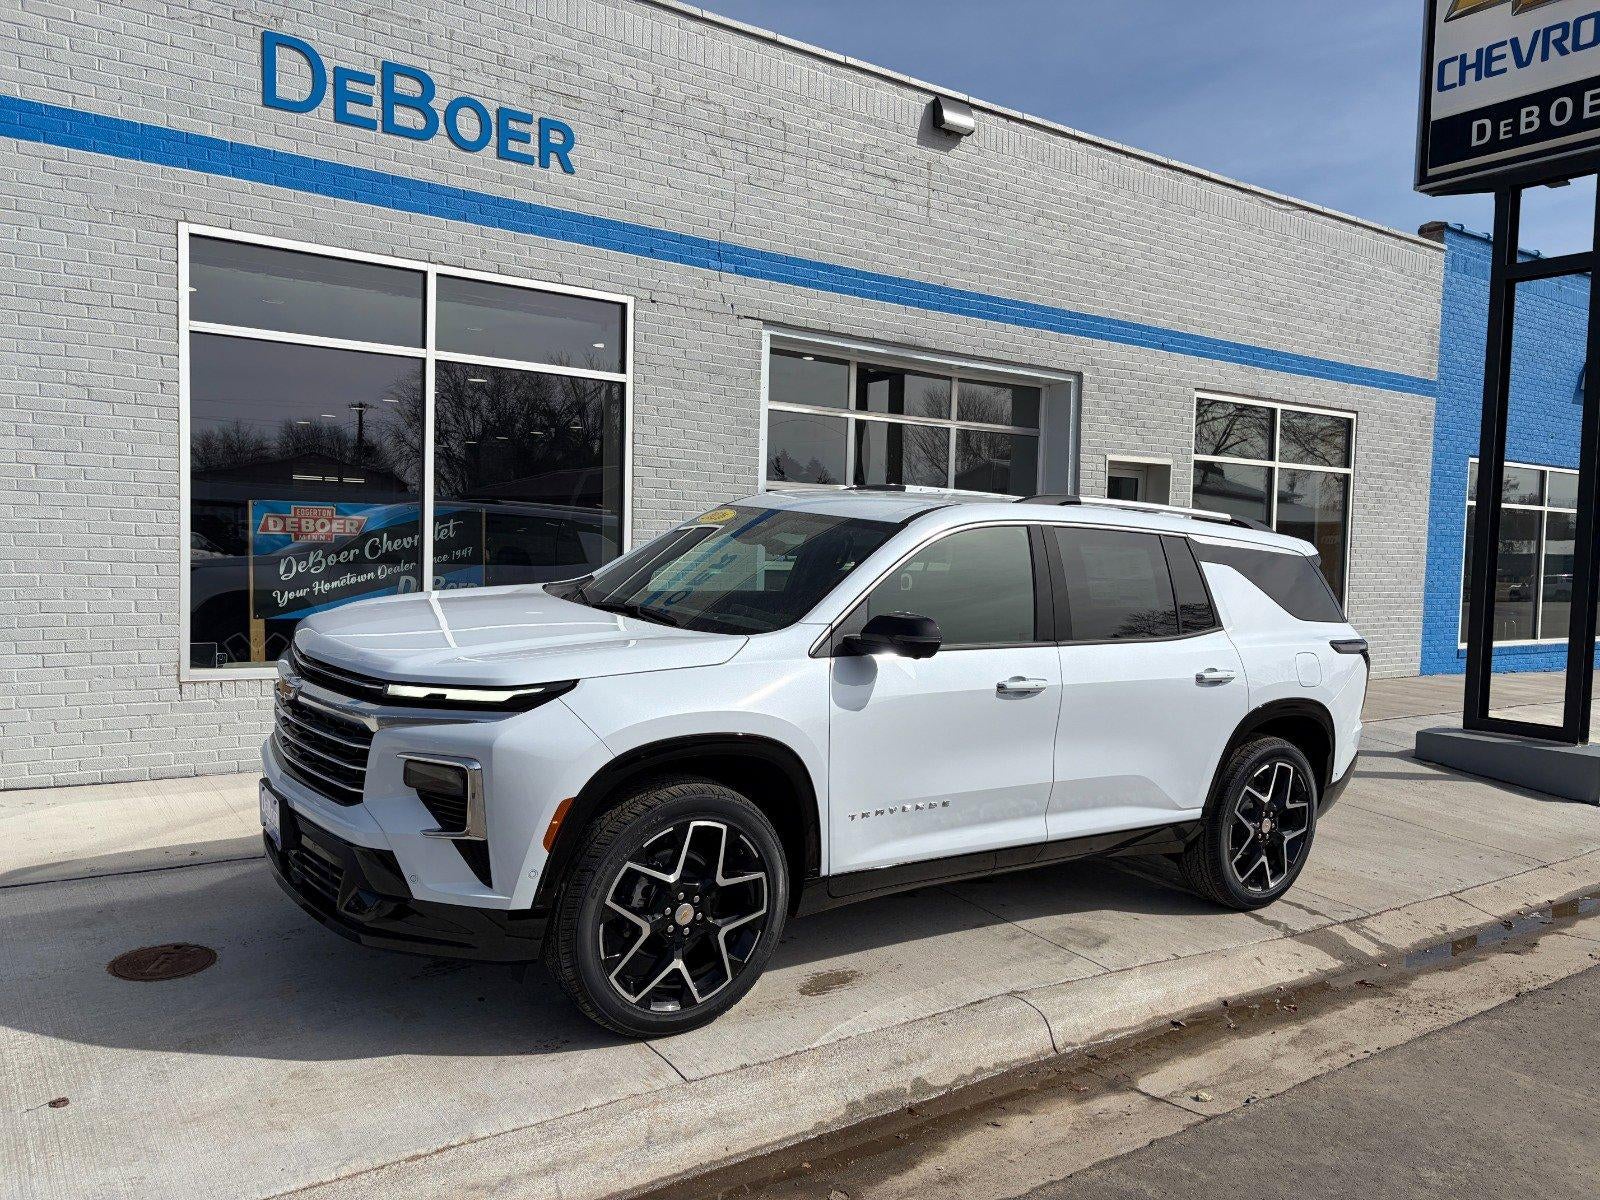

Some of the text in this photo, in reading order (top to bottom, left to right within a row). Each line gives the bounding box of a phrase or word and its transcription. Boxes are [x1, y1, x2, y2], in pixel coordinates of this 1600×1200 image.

[1437, 10, 1600, 92] CHEVRO
[267, 517, 359, 533] DEBOER
[296, 507, 332, 517] EDGERTON
[272, 588, 310, 607] Your
[312, 571, 376, 596] Hometown
[377, 560, 416, 579] Dealer
[452, 546, 473, 560] 1947
[279, 519, 463, 580] DeBoer Chevrlet
